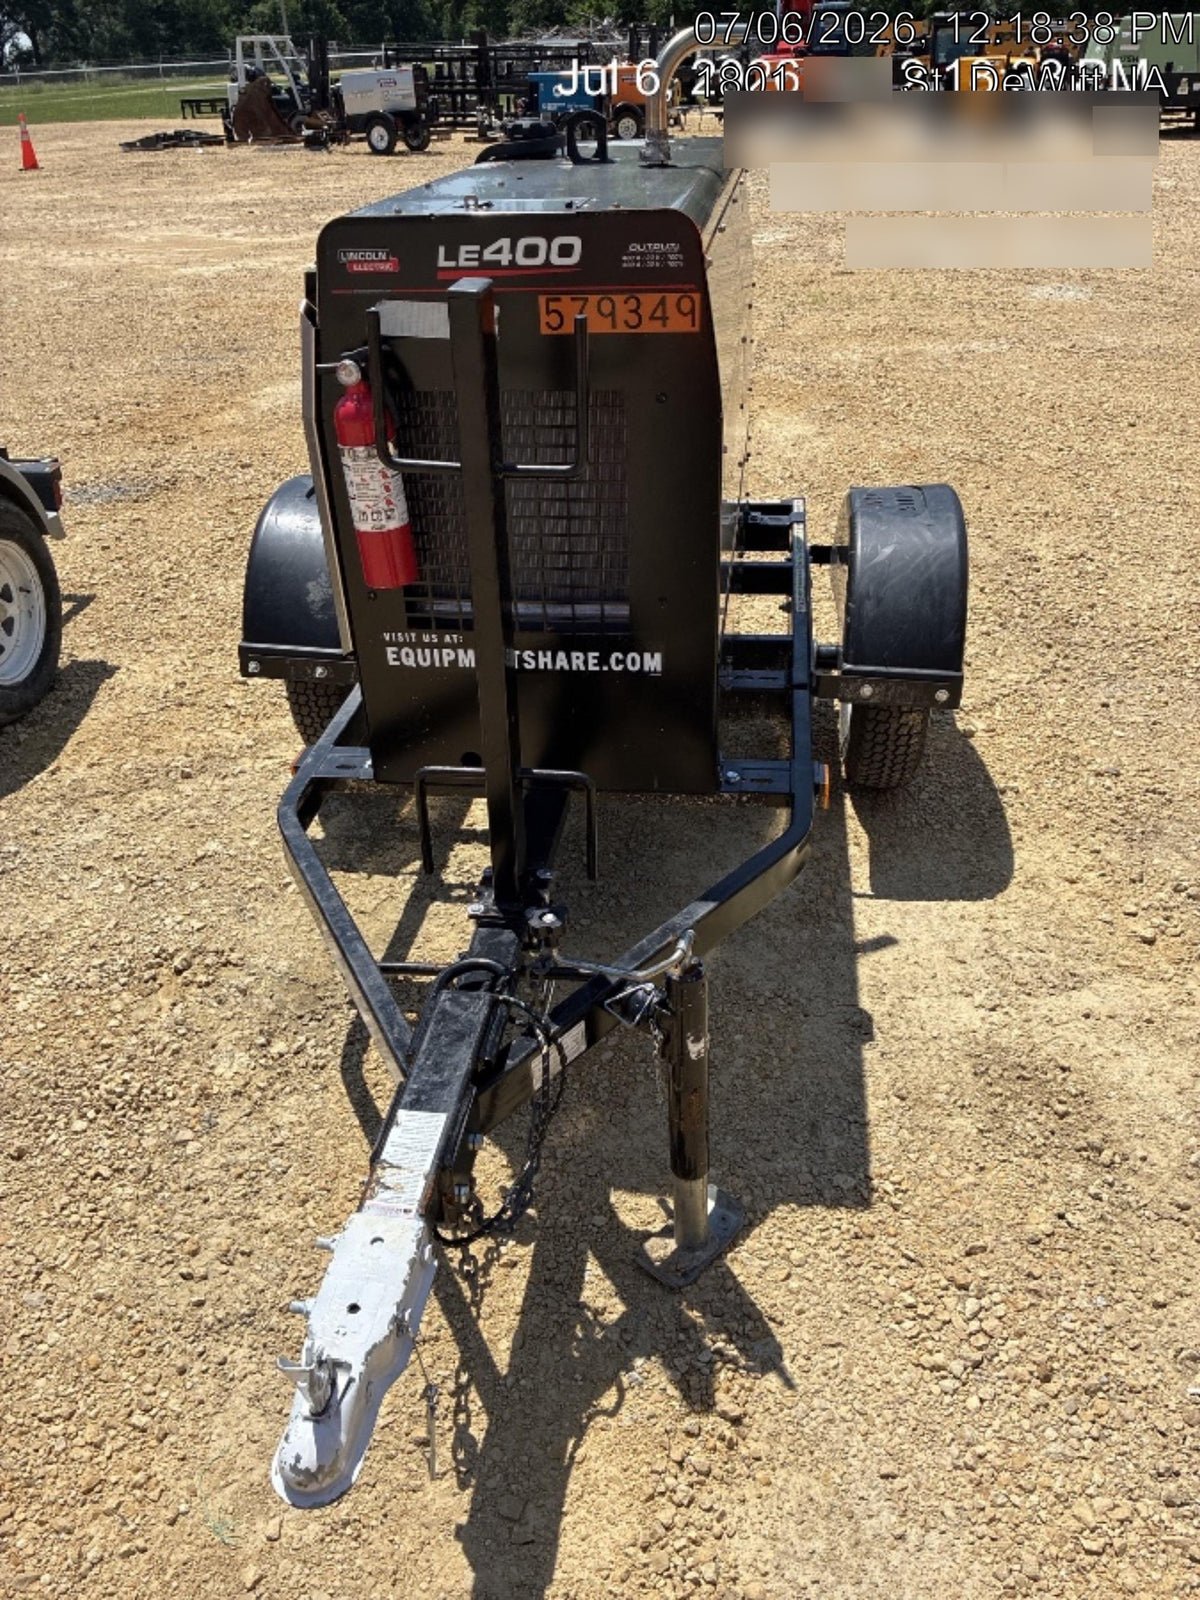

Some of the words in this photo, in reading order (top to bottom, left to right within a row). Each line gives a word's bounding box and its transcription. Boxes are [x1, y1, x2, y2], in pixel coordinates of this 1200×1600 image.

[340, 251, 387, 261] LINCOLN
[437, 236, 582, 268] LE400
[544, 294, 697, 332] 579349
[383, 632, 417, 643] VISIT
[422, 633, 439, 643] US
[444, 634, 464, 644] AT:
[385, 646, 662, 672] EQUIPMTSHARE.COM
